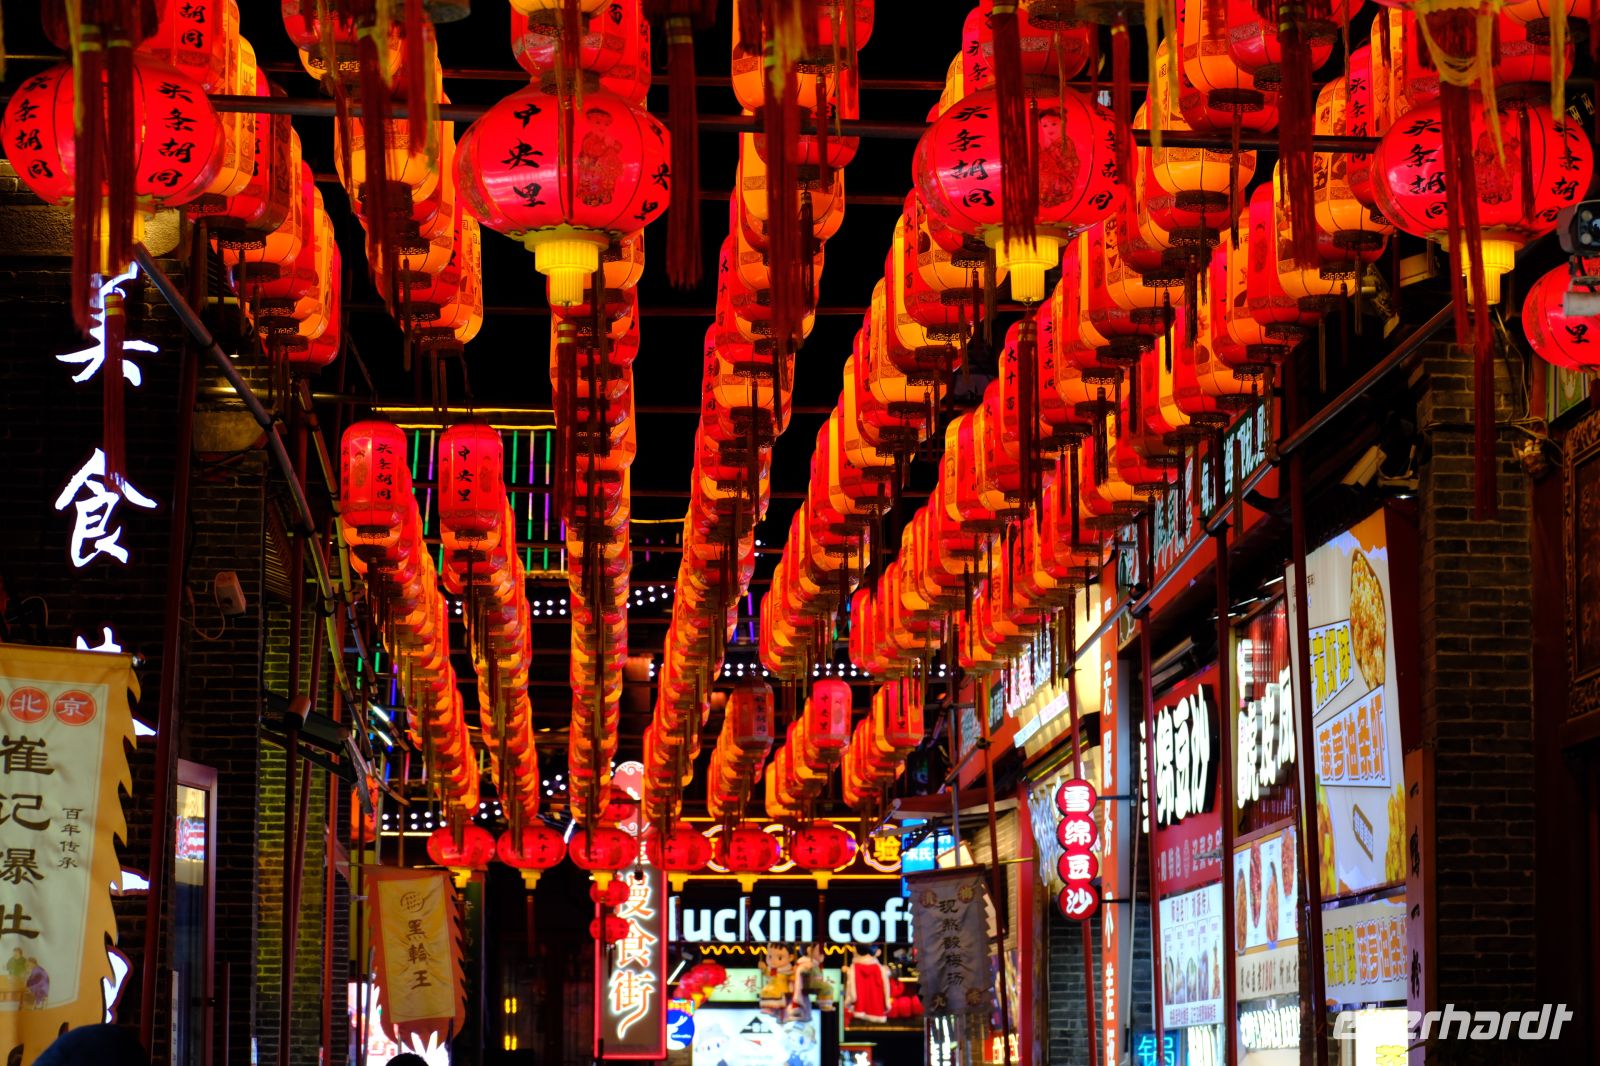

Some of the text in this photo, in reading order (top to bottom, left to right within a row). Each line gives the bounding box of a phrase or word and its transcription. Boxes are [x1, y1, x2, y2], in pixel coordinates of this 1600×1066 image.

[13, 74, 54, 179] 头条胡同
[147, 81, 198, 188] 头条胡同
[501, 103, 545, 207] 中央里
[948, 105, 997, 208] 头条胡同
[373, 443, 393, 501] 头条胡同
[456, 445, 475, 502] 中央里
[12, 694, 89, 717] 北京
[58, 807, 84, 869] 百年传承
[1064, 785, 1094, 915] 雪绵豆沙
[668, 895, 813, 943] luckin
